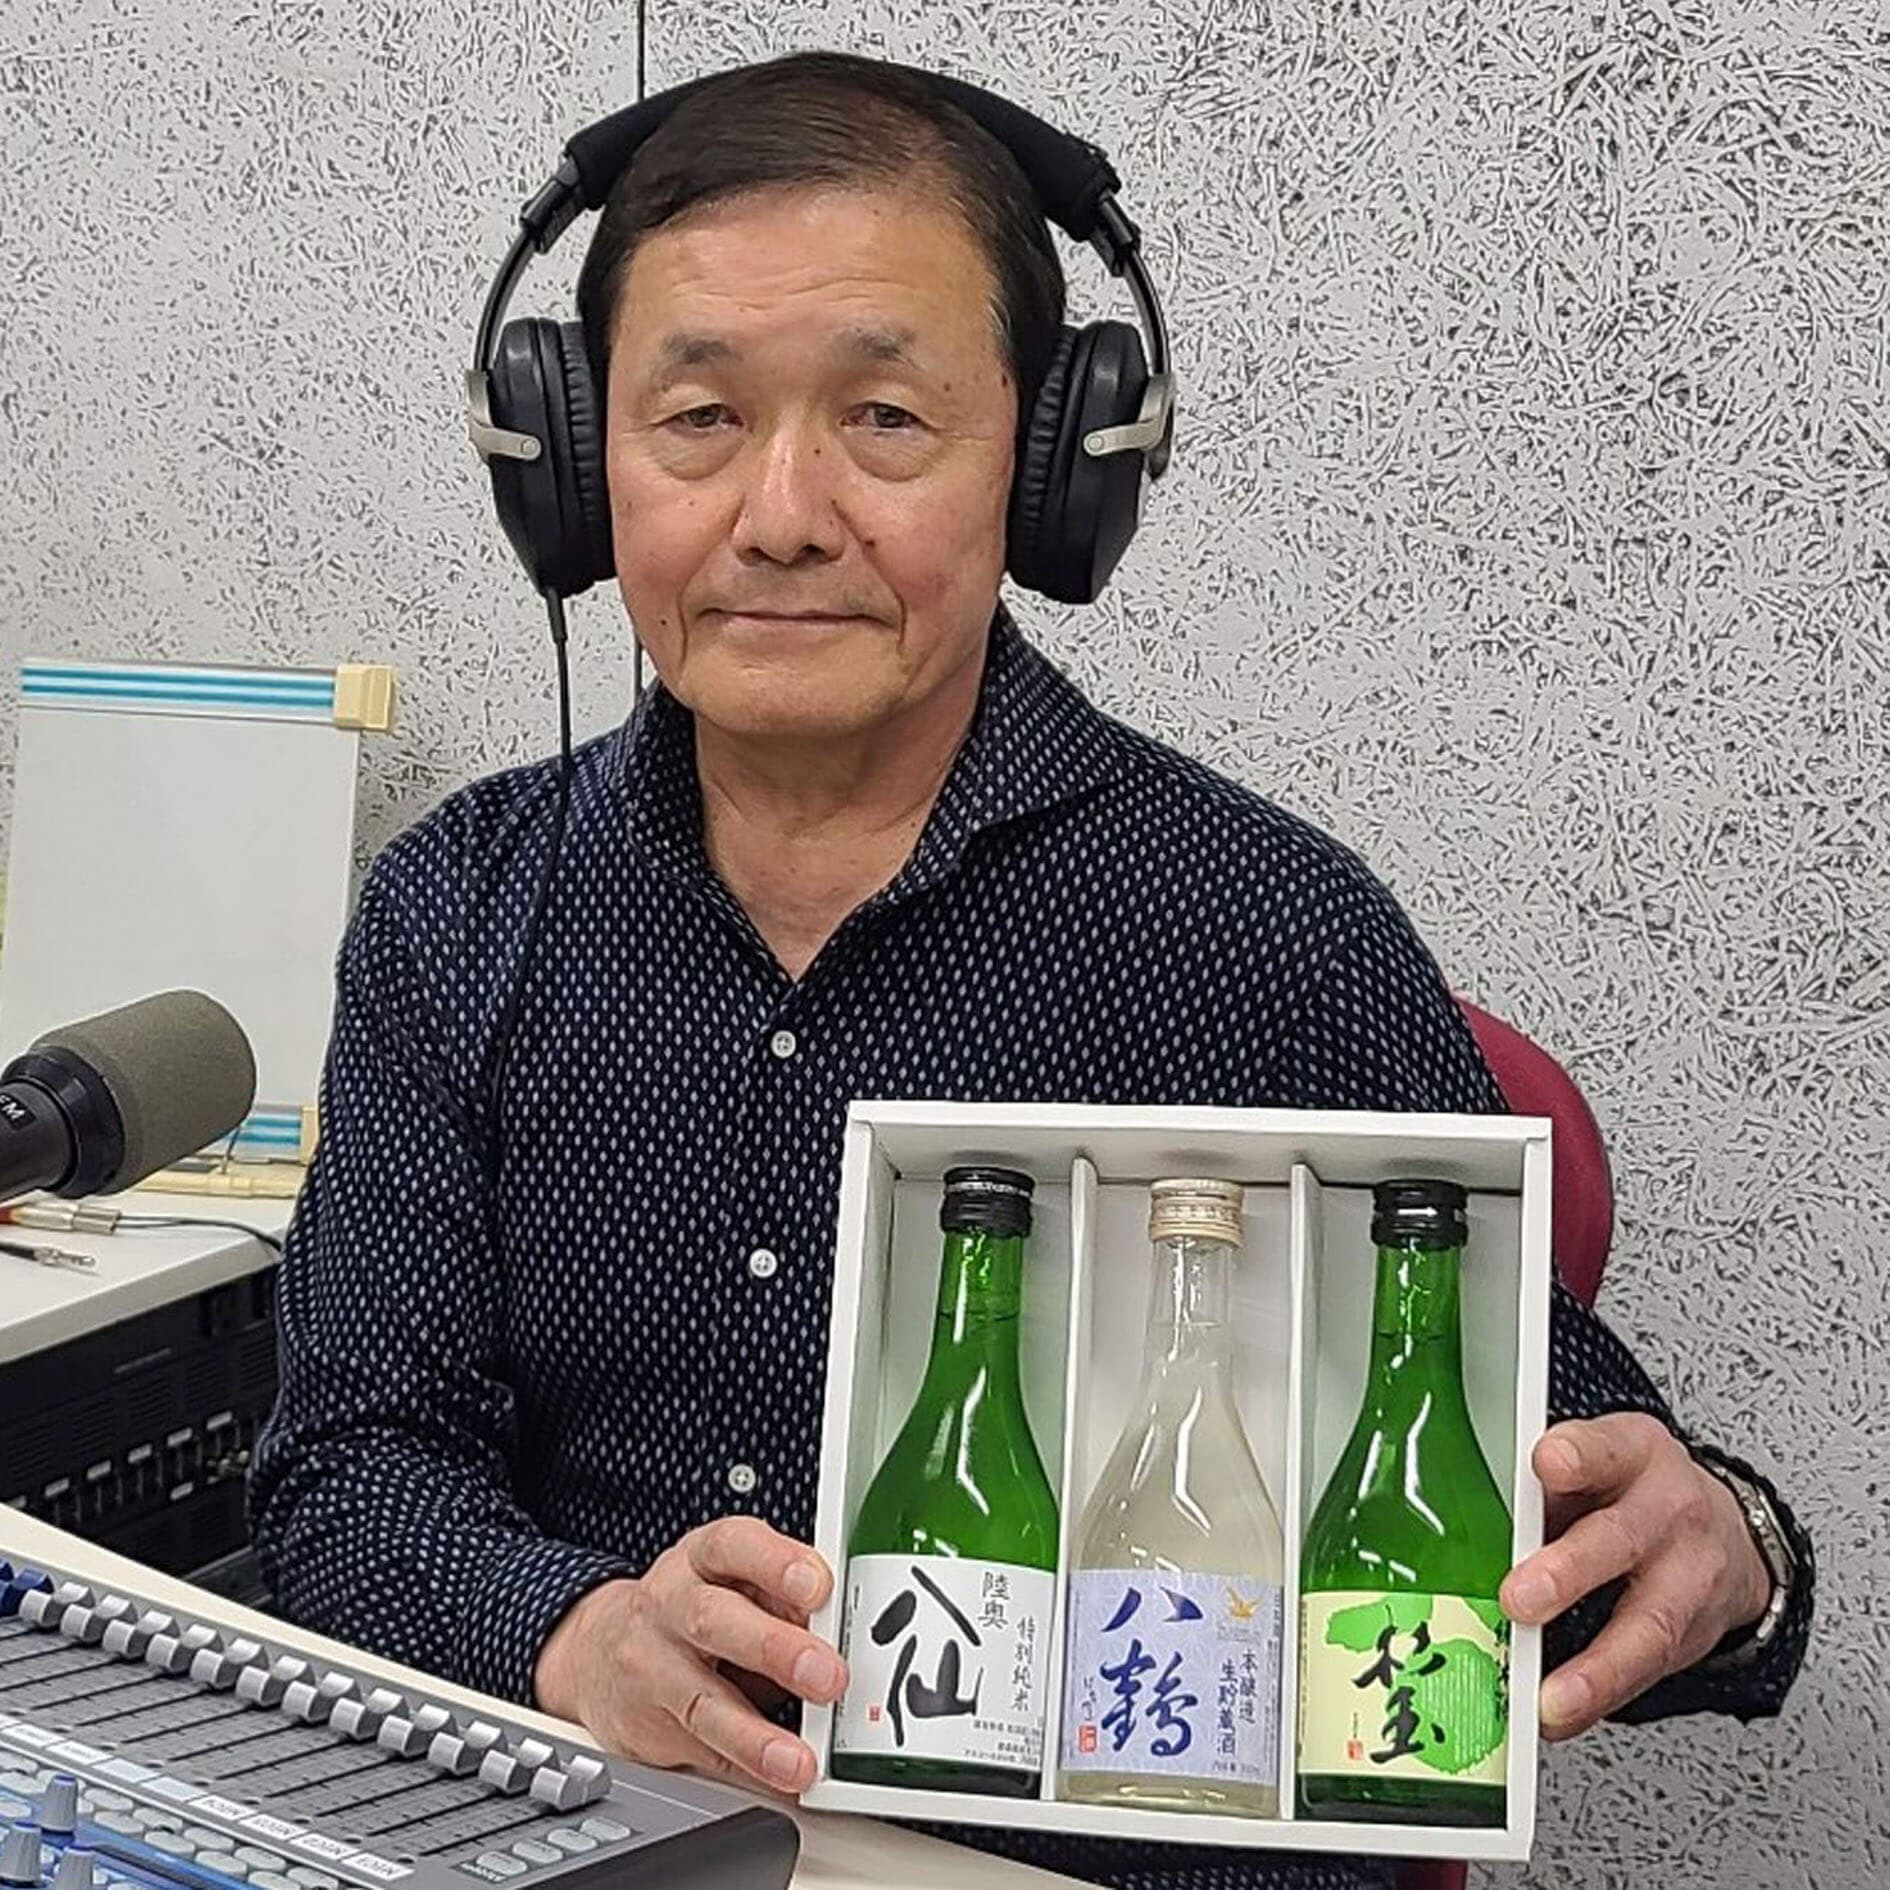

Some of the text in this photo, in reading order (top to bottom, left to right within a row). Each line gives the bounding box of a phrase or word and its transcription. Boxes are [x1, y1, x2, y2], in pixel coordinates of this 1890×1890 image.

[978, 1571, 1011, 1630] 陸奥
[871, 1565, 983, 1747] 八仙
[1012, 1616, 1035, 1713] 特別純米
[1101, 1587, 1204, 1756] 八鶴
[1239, 1649, 1258, 1725] 本醸造
[1216, 1659, 1239, 1756] 生貯蔵酒
